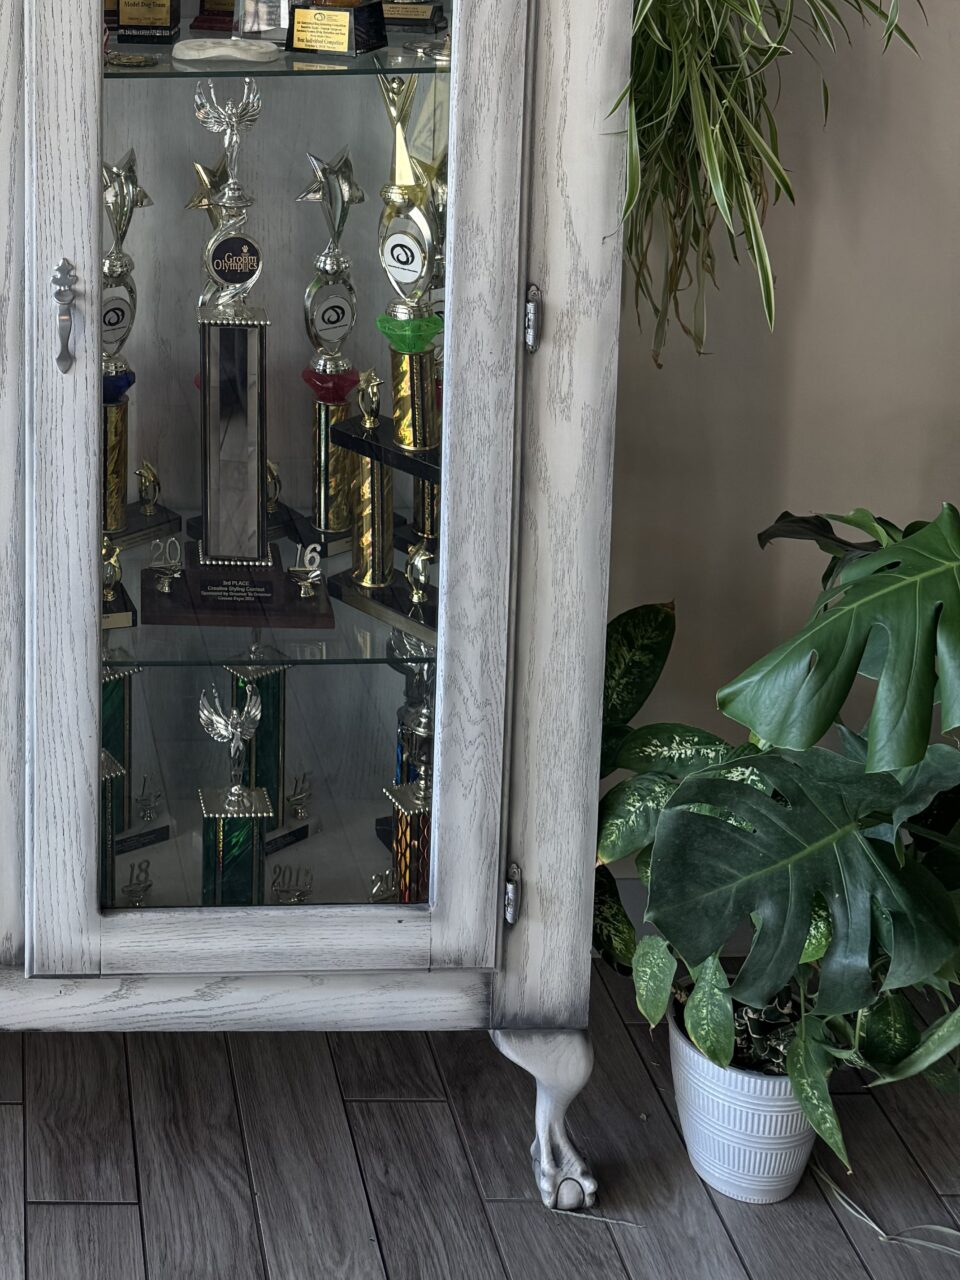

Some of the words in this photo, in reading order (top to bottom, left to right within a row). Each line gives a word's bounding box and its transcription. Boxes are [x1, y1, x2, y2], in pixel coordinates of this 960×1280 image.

[213, 259, 258, 272] Olympics
[225, 252, 257, 264] Groom
[151, 538, 181, 564] 20
[295, 543, 321, 569] 16
[128, 859, 151, 885] 18
